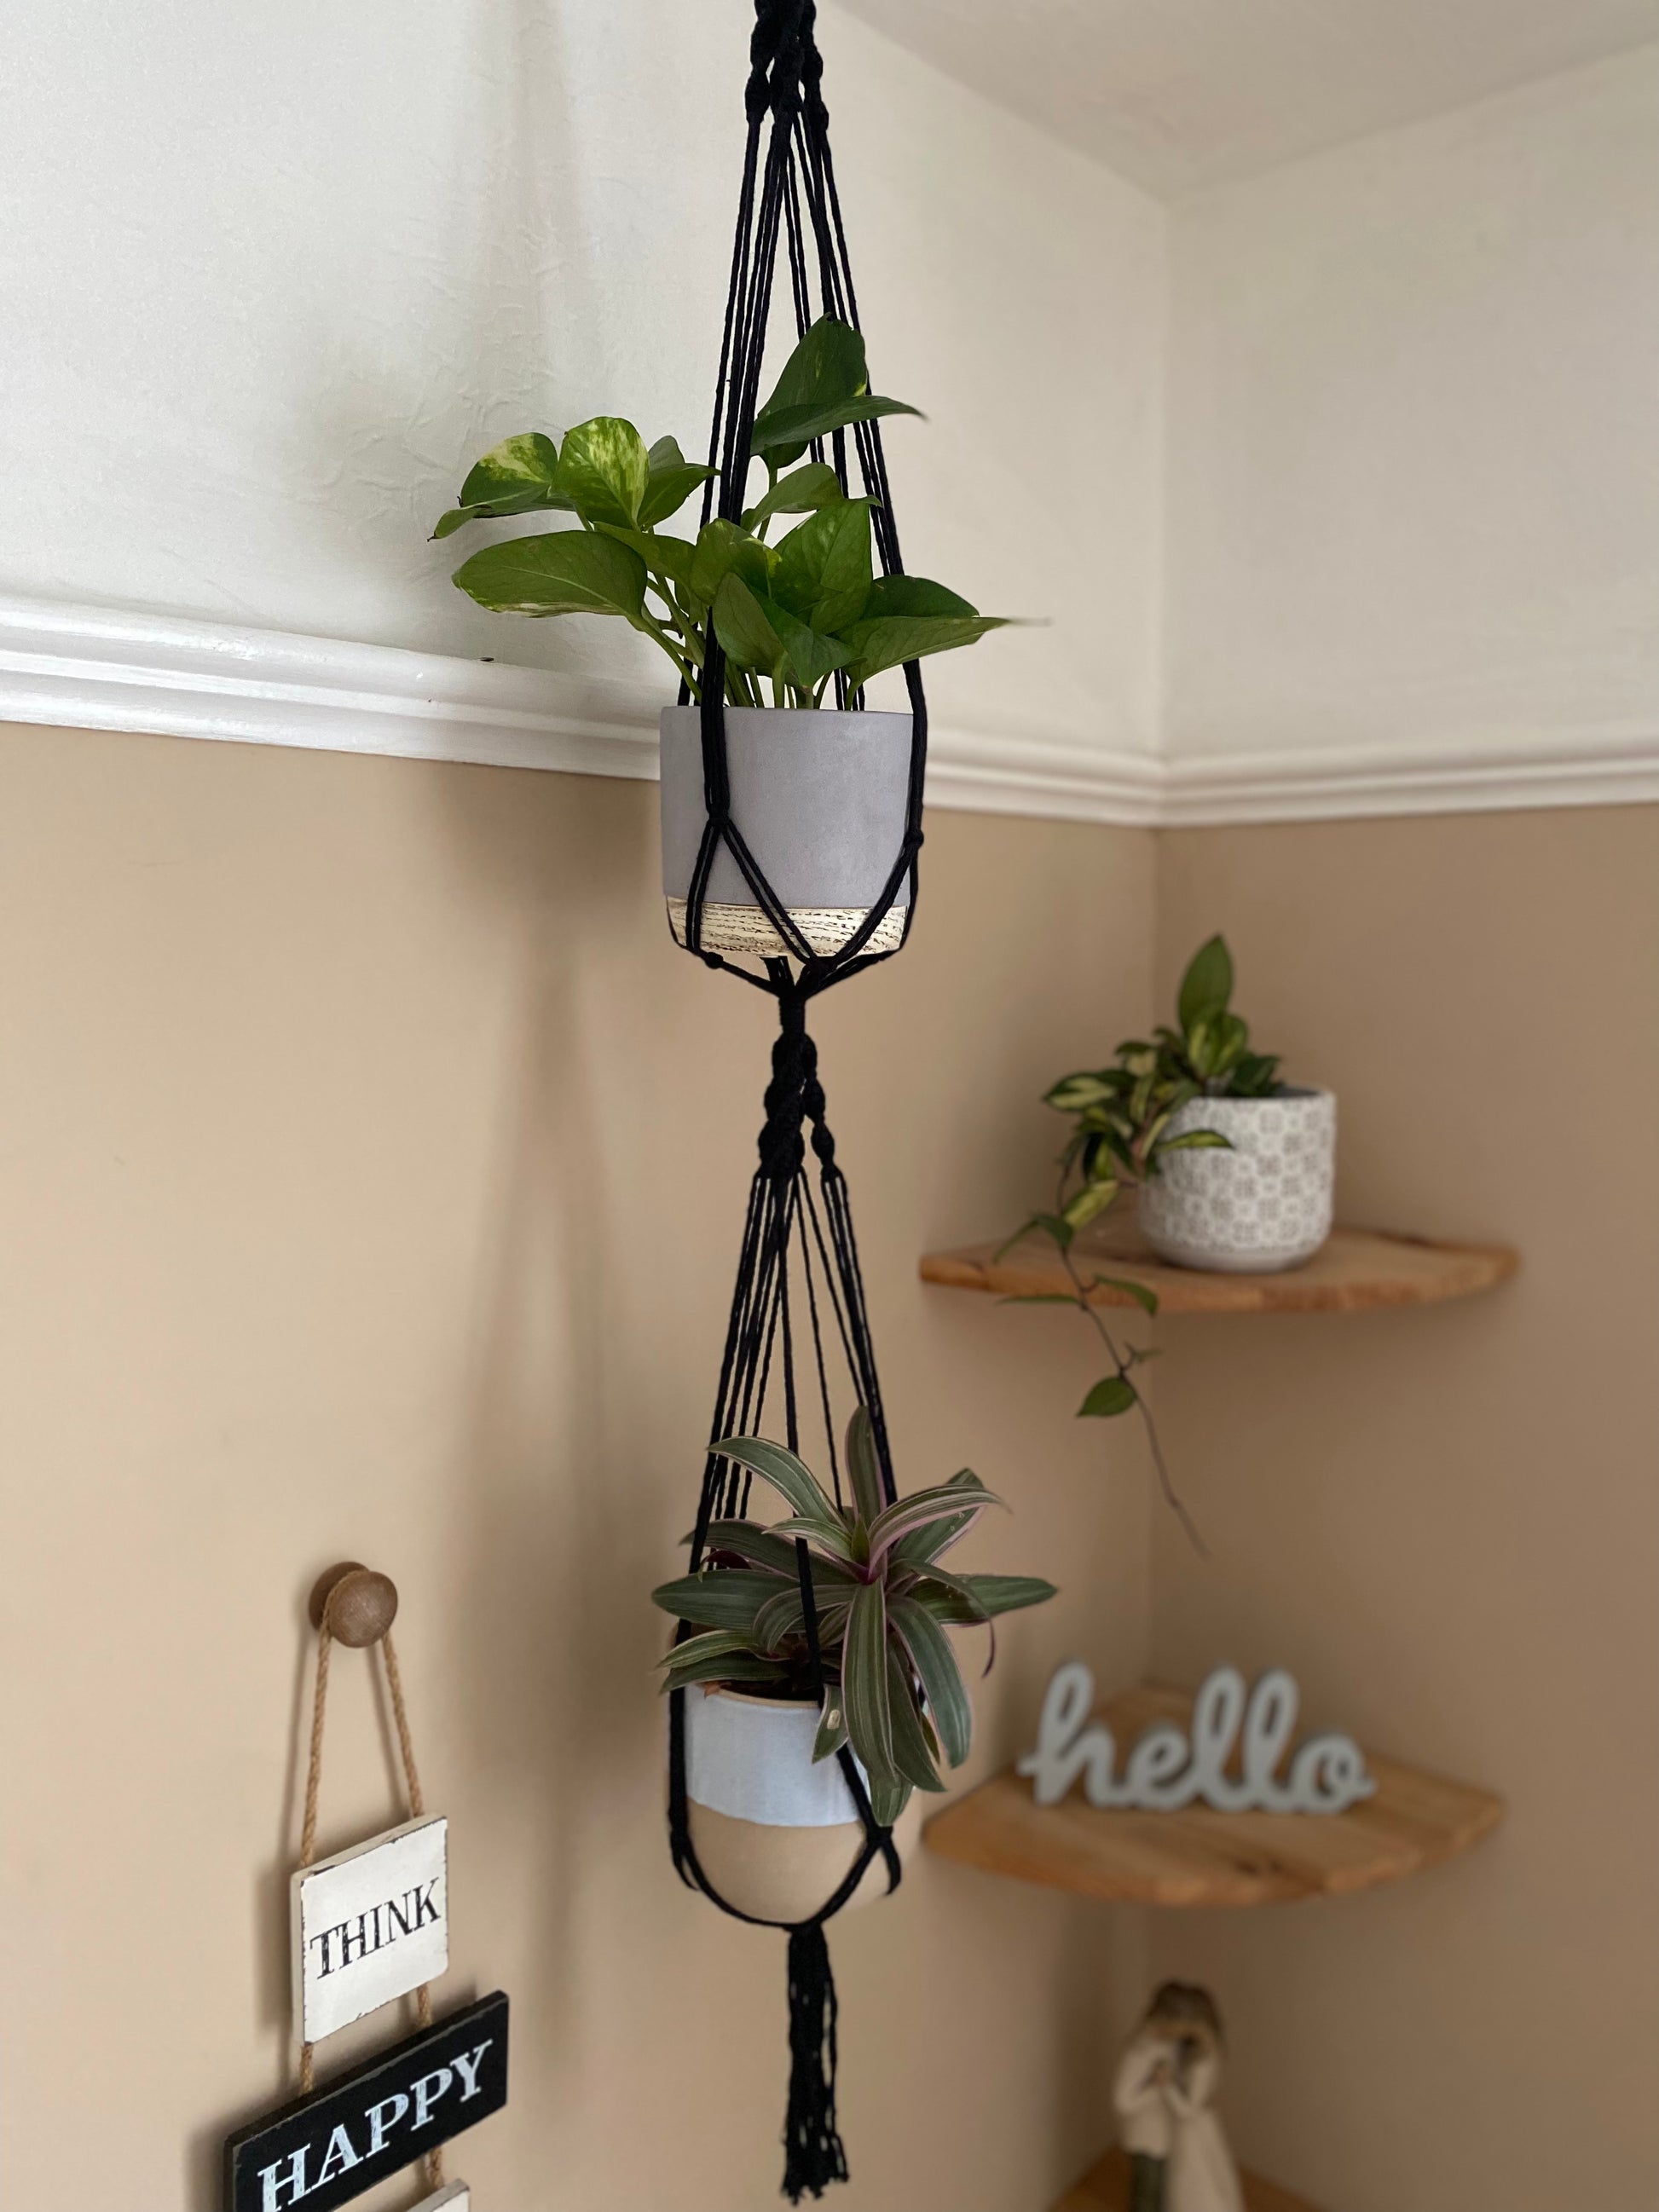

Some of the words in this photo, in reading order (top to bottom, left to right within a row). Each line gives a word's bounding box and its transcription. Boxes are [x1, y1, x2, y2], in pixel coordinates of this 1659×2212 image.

[1016, 1661, 1377, 1814] hello
[309, 1876, 442, 1979] THINK
[257, 2039, 493, 2212] HAPPY
